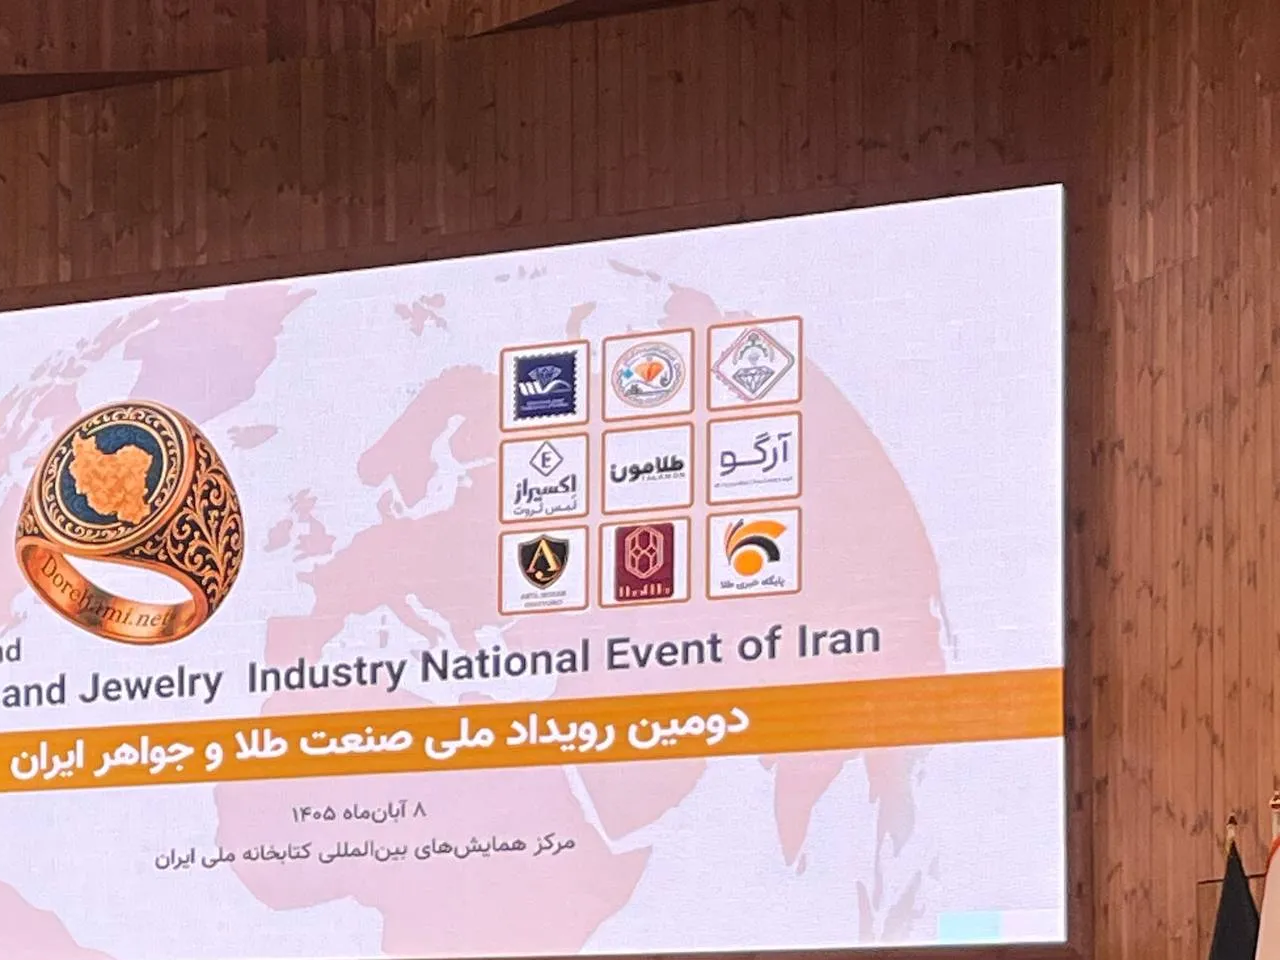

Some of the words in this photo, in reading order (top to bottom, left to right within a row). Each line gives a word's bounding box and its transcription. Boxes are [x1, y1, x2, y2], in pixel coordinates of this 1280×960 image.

[610, 455, 684, 483] طلامون
[719, 432, 792, 477] آرگو
[1, 673, 67, 708] and
[78, 665, 224, 705] Jewelry
[248, 656, 408, 693] Industry
[420, 637, 590, 683] National
[606, 631, 722, 671] Event
[737, 623, 783, 662] of
[798, 623, 881, 658] Iran
[299, 726, 414, 756] صنعت
[424, 717, 496, 760] ملی
[506, 713, 616, 752] رویداد
[627, 706, 750, 748] دومین
[10, 739, 84, 781] ایران
[93, 736, 195, 778] جواهر
[205, 740, 224, 773] و
[235, 728, 288, 760] طلا
[291, 805, 336, 823] ۱۴۰۵
[412, 801, 427, 818] ۸
[155, 847, 195, 870] ایران
[201, 846, 236, 868] ملی
[242, 842, 312, 865] کتابخانه
[533, 833, 576, 856] مرکز
